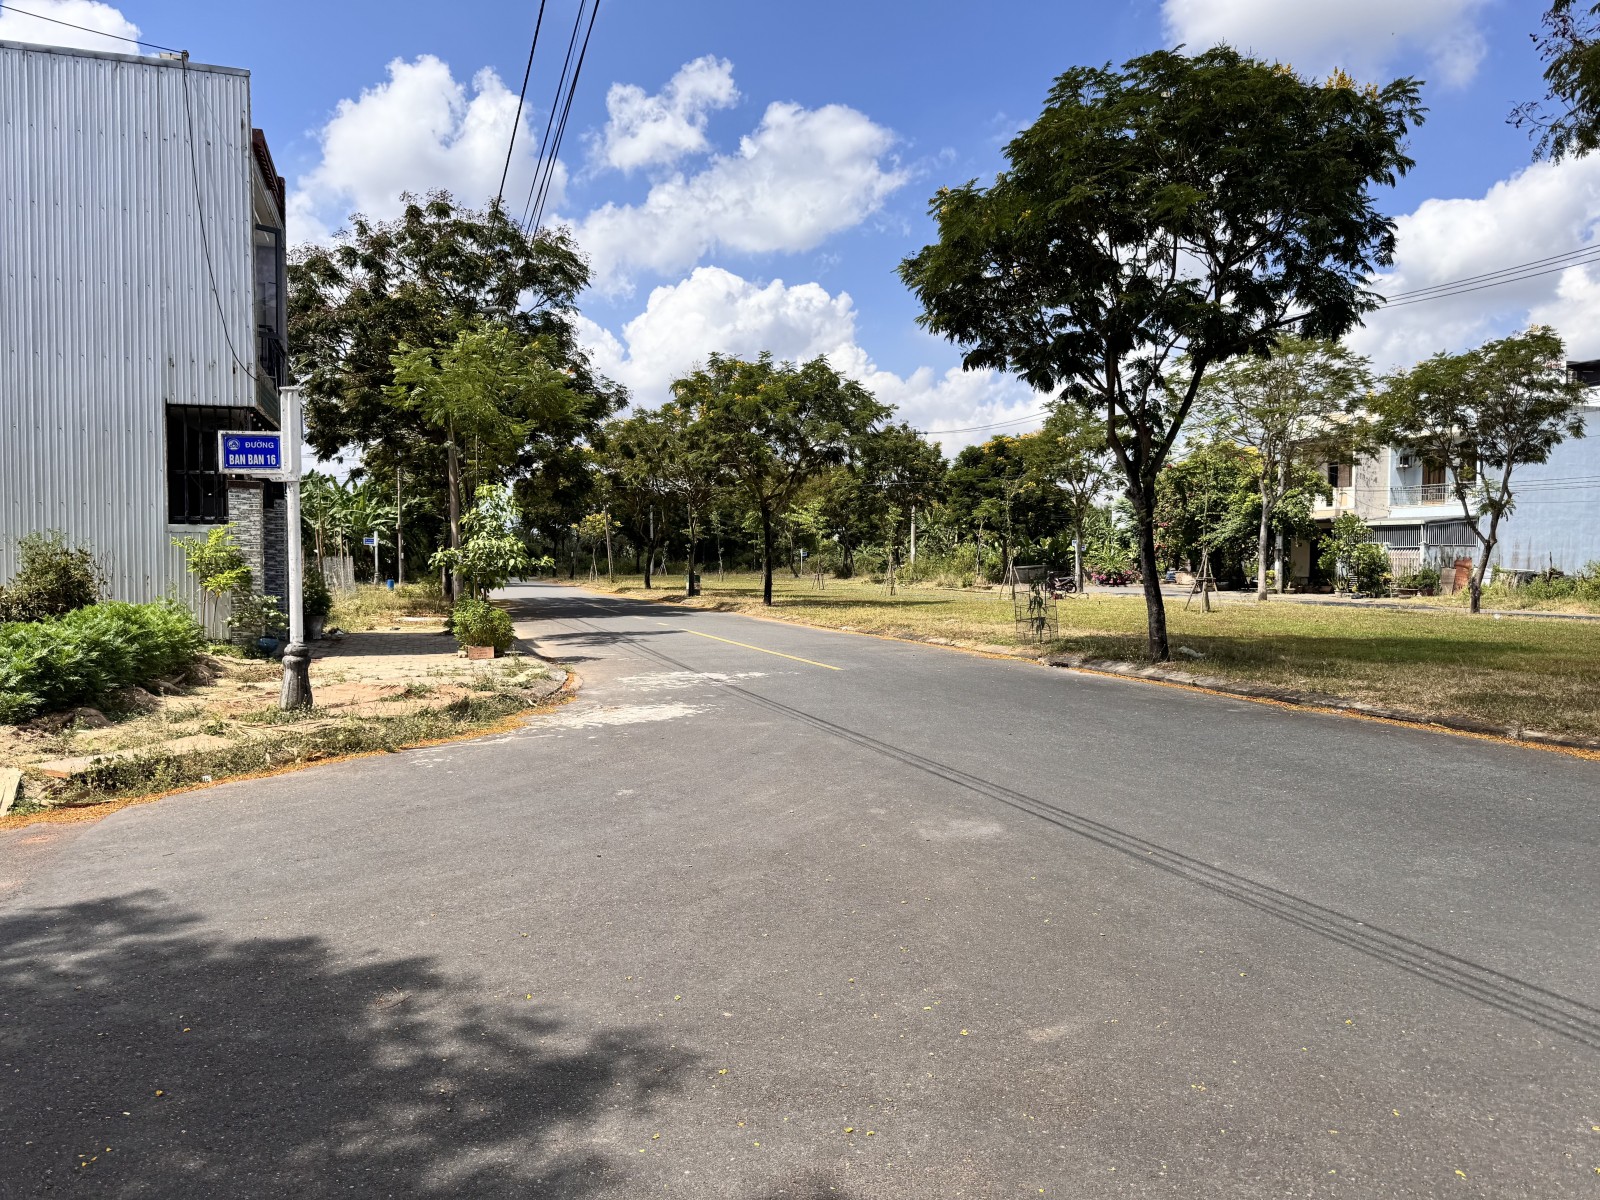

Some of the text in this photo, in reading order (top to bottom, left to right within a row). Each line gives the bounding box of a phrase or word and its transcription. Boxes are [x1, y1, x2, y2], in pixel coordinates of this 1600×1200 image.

[245, 440, 274, 448] ĐƯỜNG
[229, 454, 276, 465] BAN BAN 16
